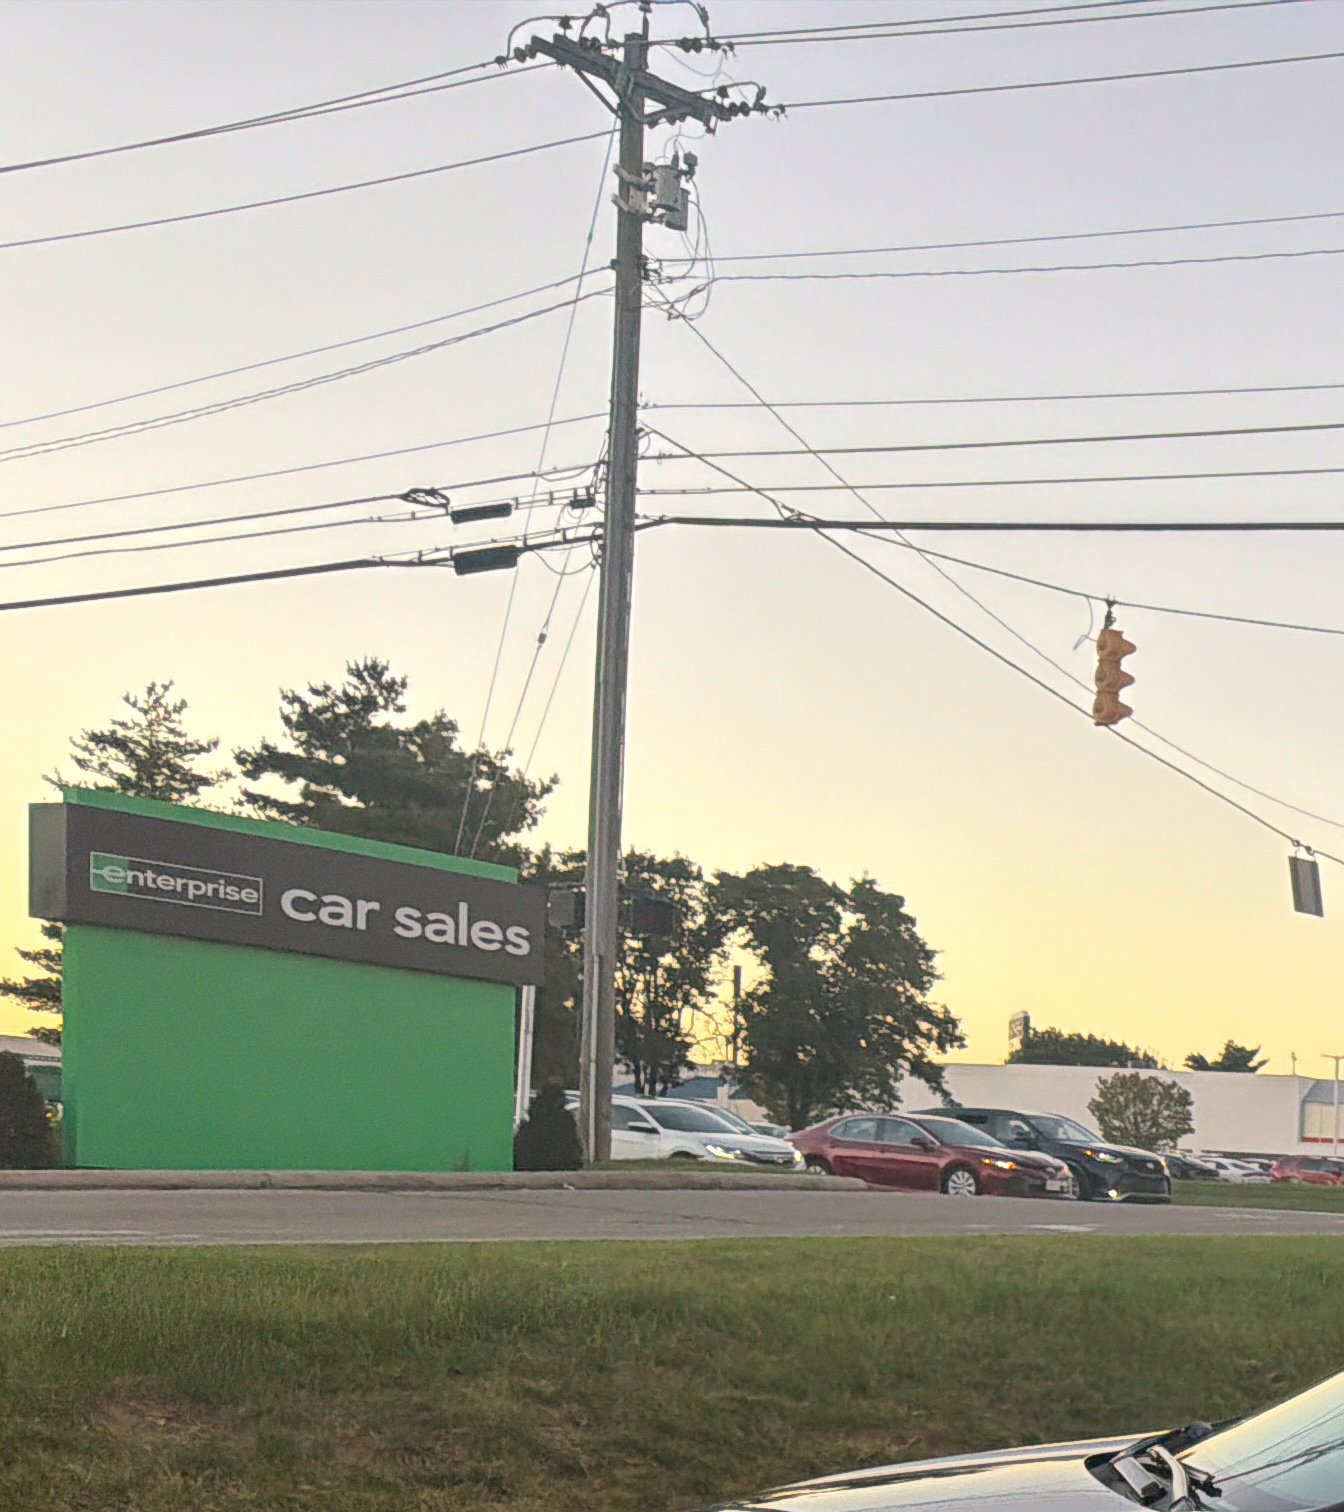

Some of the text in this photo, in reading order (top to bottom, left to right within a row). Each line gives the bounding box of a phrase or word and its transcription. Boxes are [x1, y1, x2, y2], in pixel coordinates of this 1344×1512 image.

[97, 863, 259, 904] enterprise
[280, 888, 532, 956] car sales
